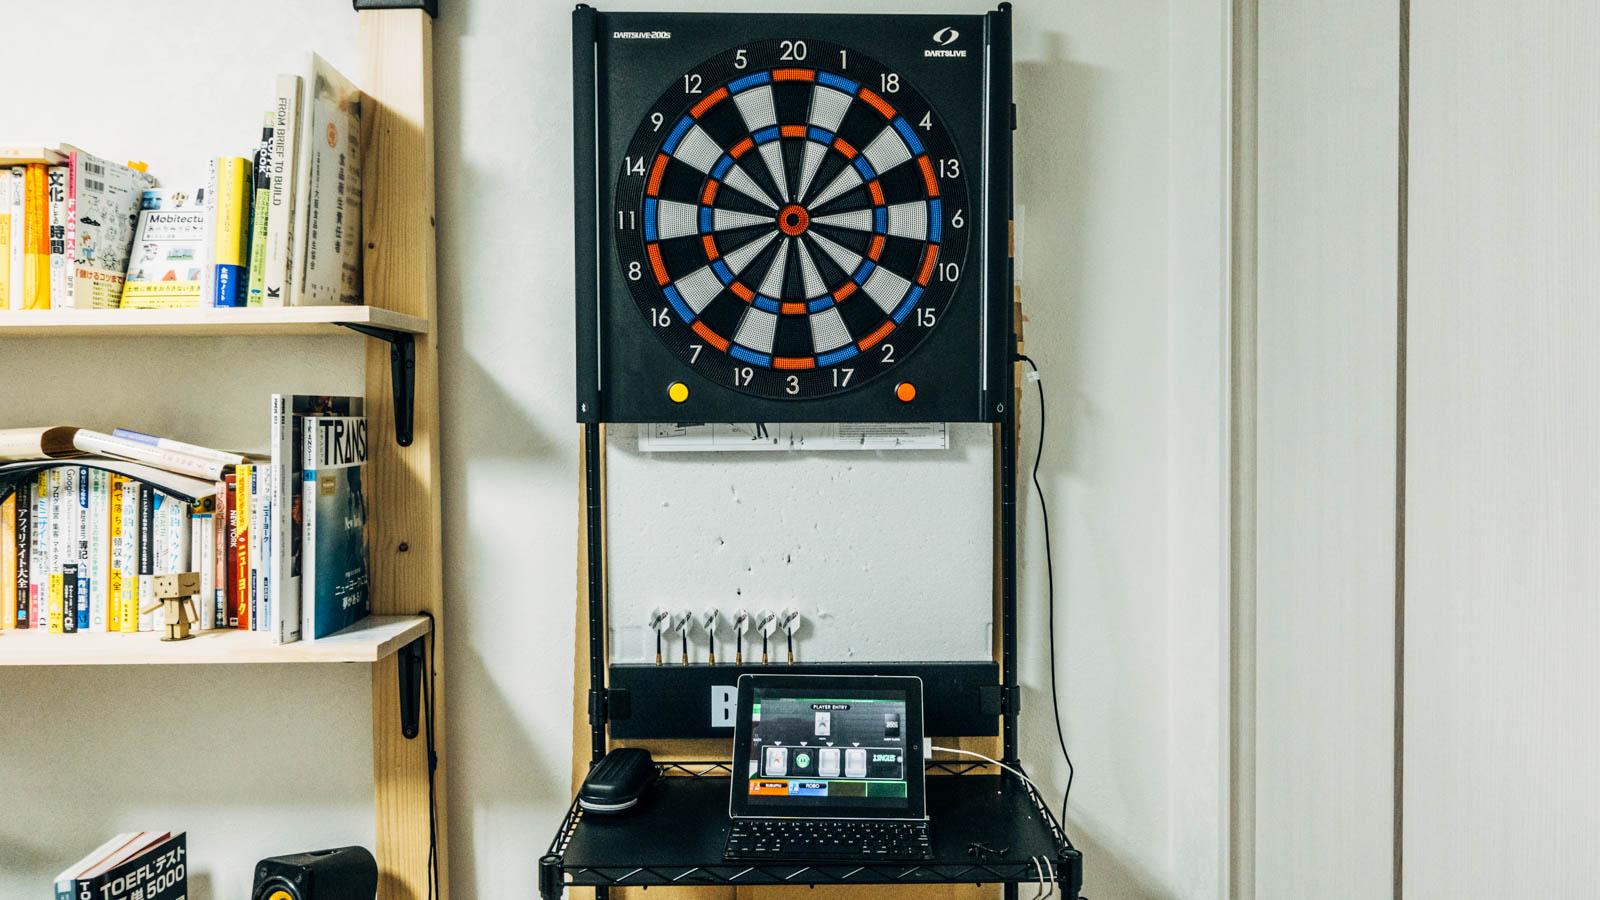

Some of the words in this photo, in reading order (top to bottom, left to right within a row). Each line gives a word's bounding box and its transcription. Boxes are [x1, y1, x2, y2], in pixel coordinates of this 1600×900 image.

[734, 49, 748, 70] 5
[780, 40, 807, 61] 20
[839, 50, 847, 70] 1
[924, 49, 967, 57] DARTSLIVE
[684, 73, 702, 94] 12
[880, 72, 900, 93] 18
[277, 97, 288, 126] FROM
[918, 111, 933, 131] 4
[650, 112, 664, 132] 9
[275, 128, 286, 158] BRIEF
[258, 141, 268, 174] BOOK
[274, 160, 284, 173] TO
[625, 155, 646, 176] 14
[939, 158, 960, 179] 13
[273, 175, 284, 206] BUILD
[150, 215, 204, 224] Mobitectu
[618, 210, 635, 230] 11
[951, 209, 964, 229] 6
[628, 261, 642, 281] 8
[939, 262, 959, 282] 10
[651, 307, 671, 328] 16
[917, 307, 936, 328] 15
[689, 344, 703, 364] 7
[881, 343, 895, 363] 2
[734, 367, 754, 387] 19
[785, 375, 800, 395] 3
[832, 368, 855, 388] 17
[66, 469, 76, 497] Google
[305, 471, 313, 480] 41
[230, 510, 238, 526] NEW
[230, 527, 238, 548] YORK
[238, 545, 246, 615] ニューヨーク
